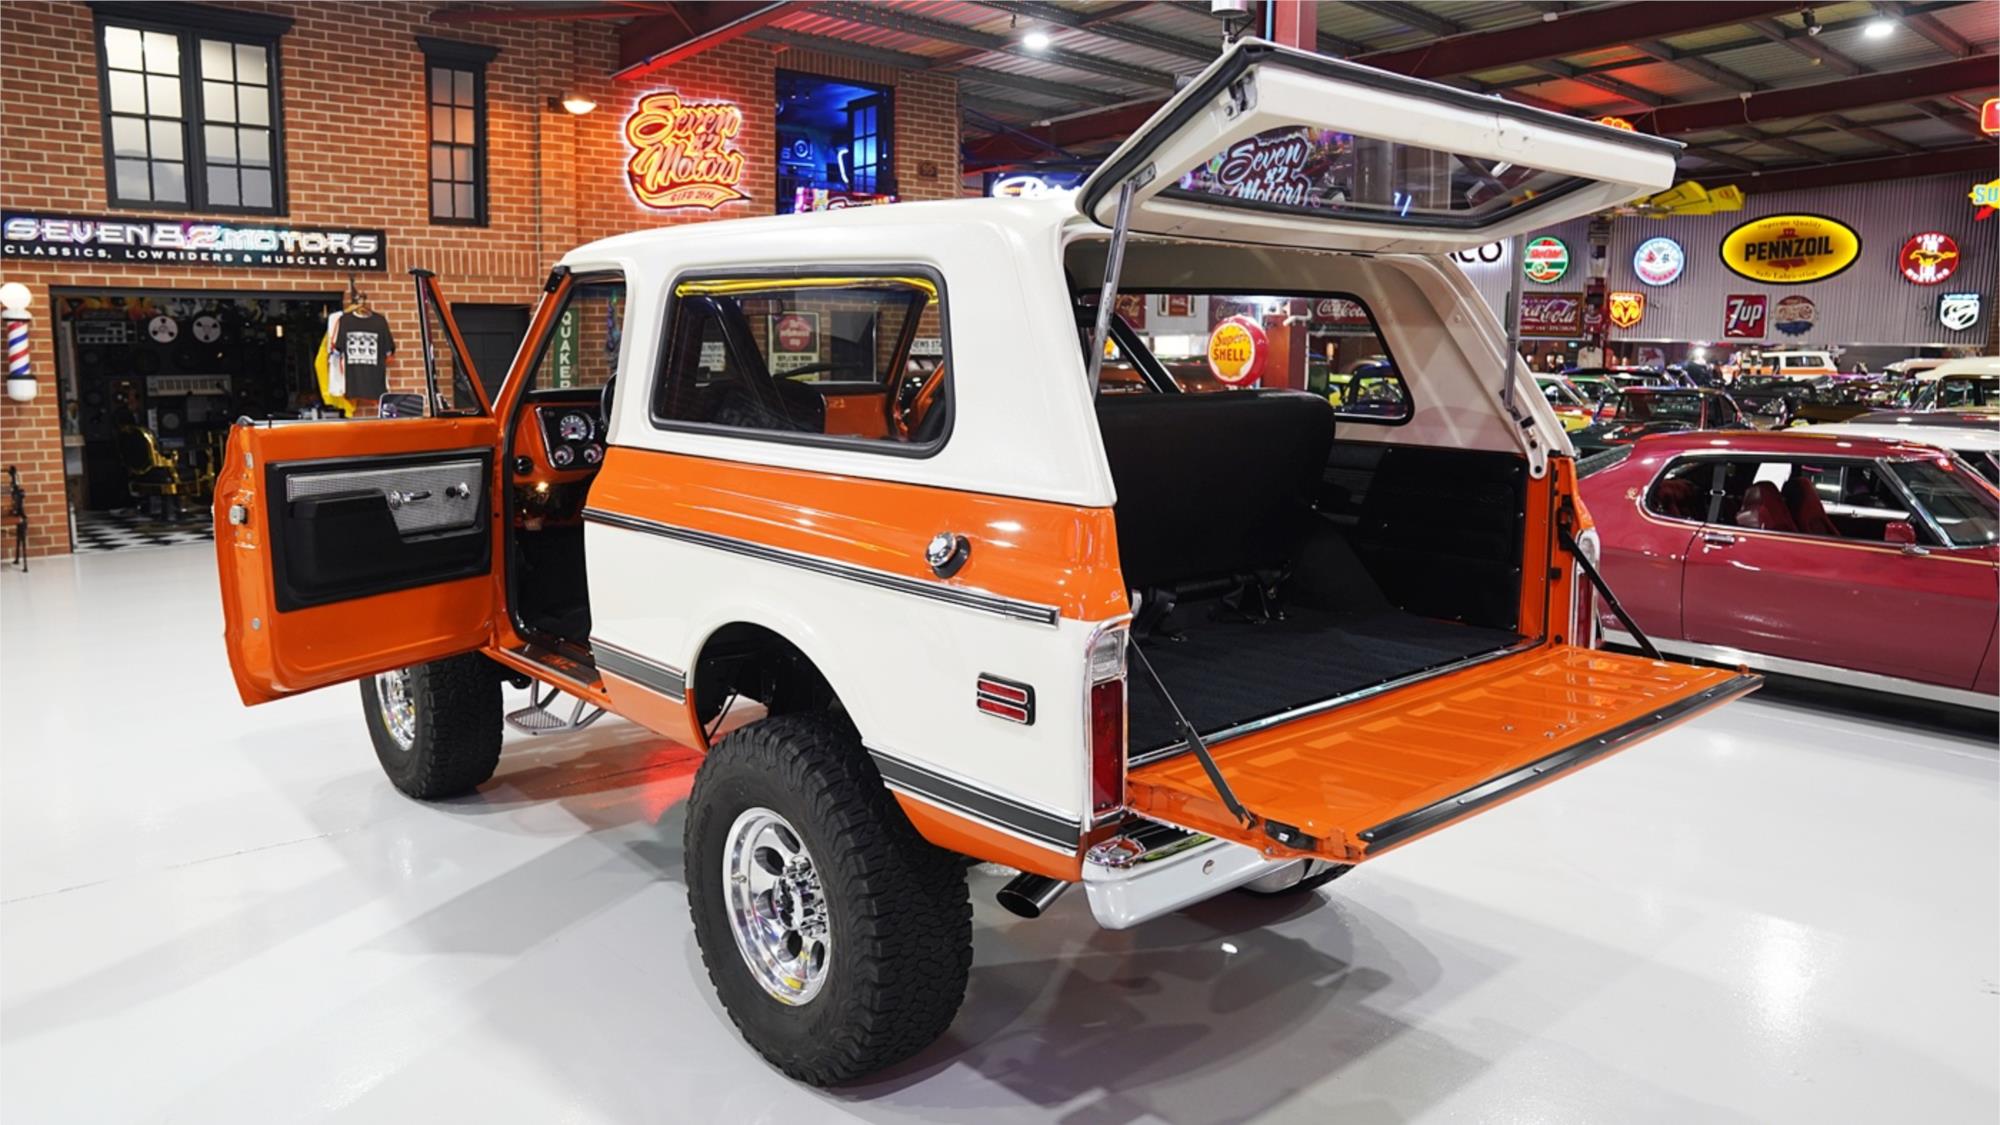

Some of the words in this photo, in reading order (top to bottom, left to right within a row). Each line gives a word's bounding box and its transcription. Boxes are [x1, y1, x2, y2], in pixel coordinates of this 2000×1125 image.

[629, 94, 742, 149] Seven
[633, 142, 744, 192] Motors
[1221, 142, 1302, 185] Seven
[1228, 178, 1304, 206] Motors
[4, 244, 113, 259] CLASSICS,
[125, 249, 233, 262] LOWRIDERS
[242, 252, 253, 263] &
[261, 254, 329, 266] MUSCLE
[336, 256, 378, 267] CARS
[1744, 235, 1834, 262] PENNZOIL
[1213, 348, 1246, 362] SHELL
